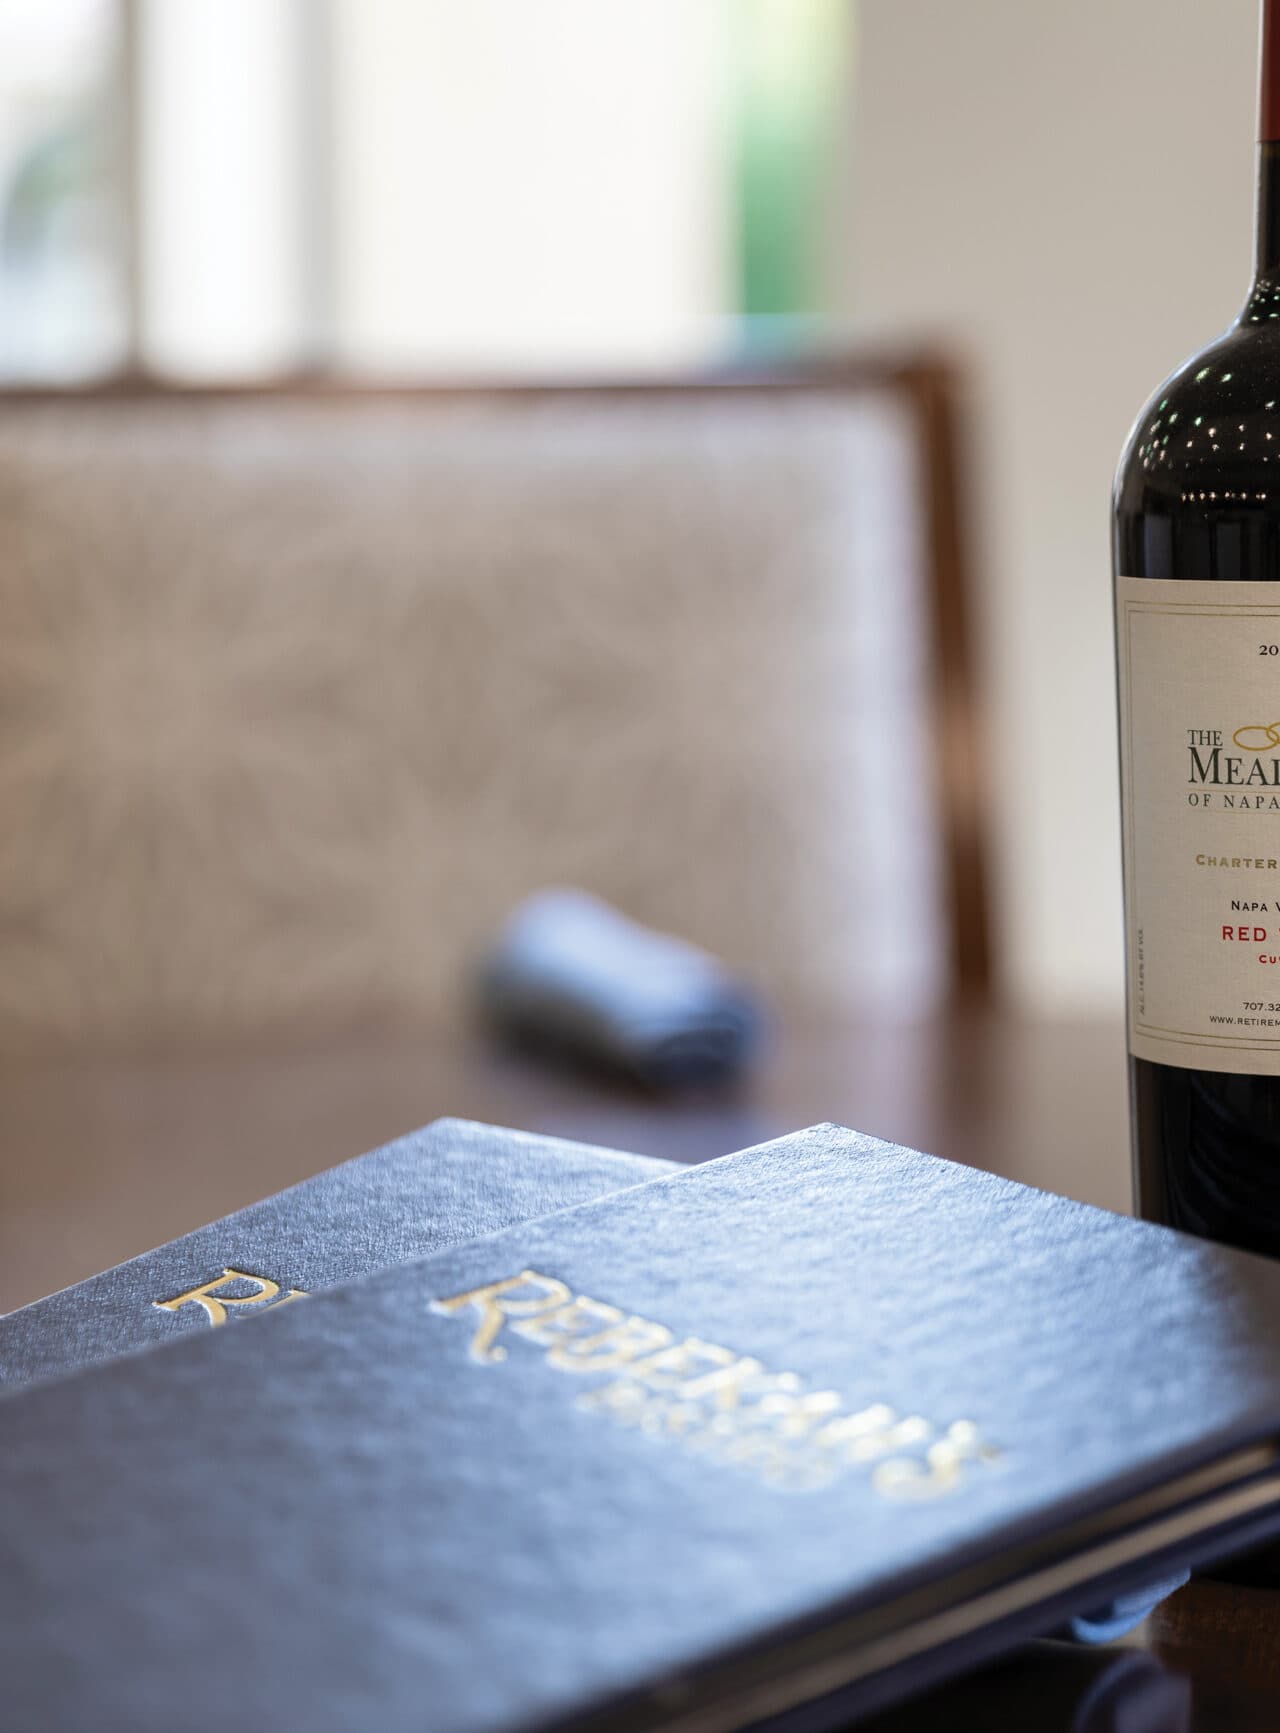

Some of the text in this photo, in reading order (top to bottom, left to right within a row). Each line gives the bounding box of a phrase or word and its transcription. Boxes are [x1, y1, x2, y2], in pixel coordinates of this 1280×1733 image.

[1187, 729, 1224, 747] THE
[1188, 792, 1212, 808] OF
[1223, 794, 1280, 810] NAPA
[1195, 853, 1278, 870] CHARTER
[1231, 900, 1268, 912] NAPA
[1222, 925, 1267, 942] RED
